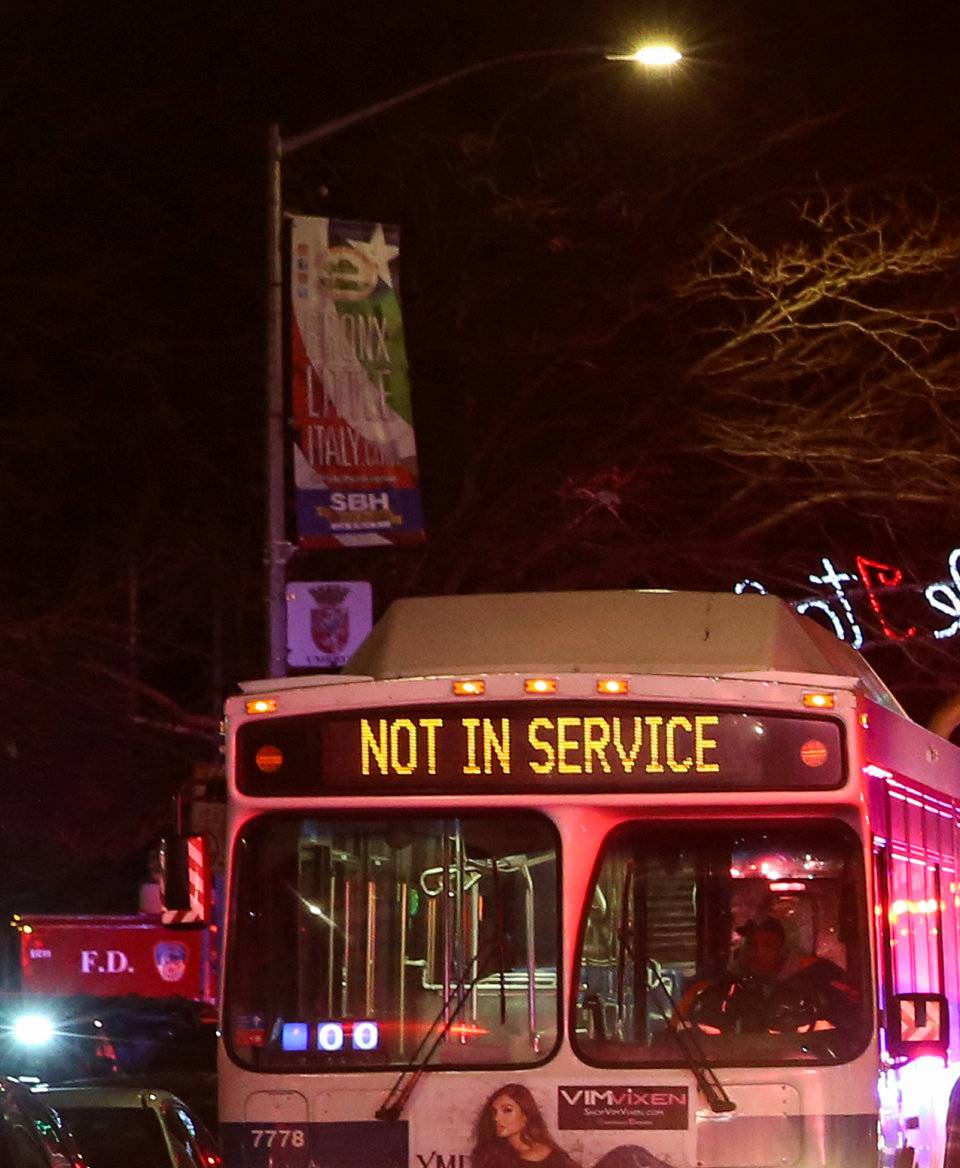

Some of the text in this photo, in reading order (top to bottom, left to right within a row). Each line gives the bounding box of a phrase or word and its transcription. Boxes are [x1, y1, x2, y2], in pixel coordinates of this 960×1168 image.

[330, 491, 390, 513] SBH
[360, 715, 720, 775] NOT IN SERVICE
[81, 950, 135, 974] F.D.
[250, 1129, 305, 1148] 7778
